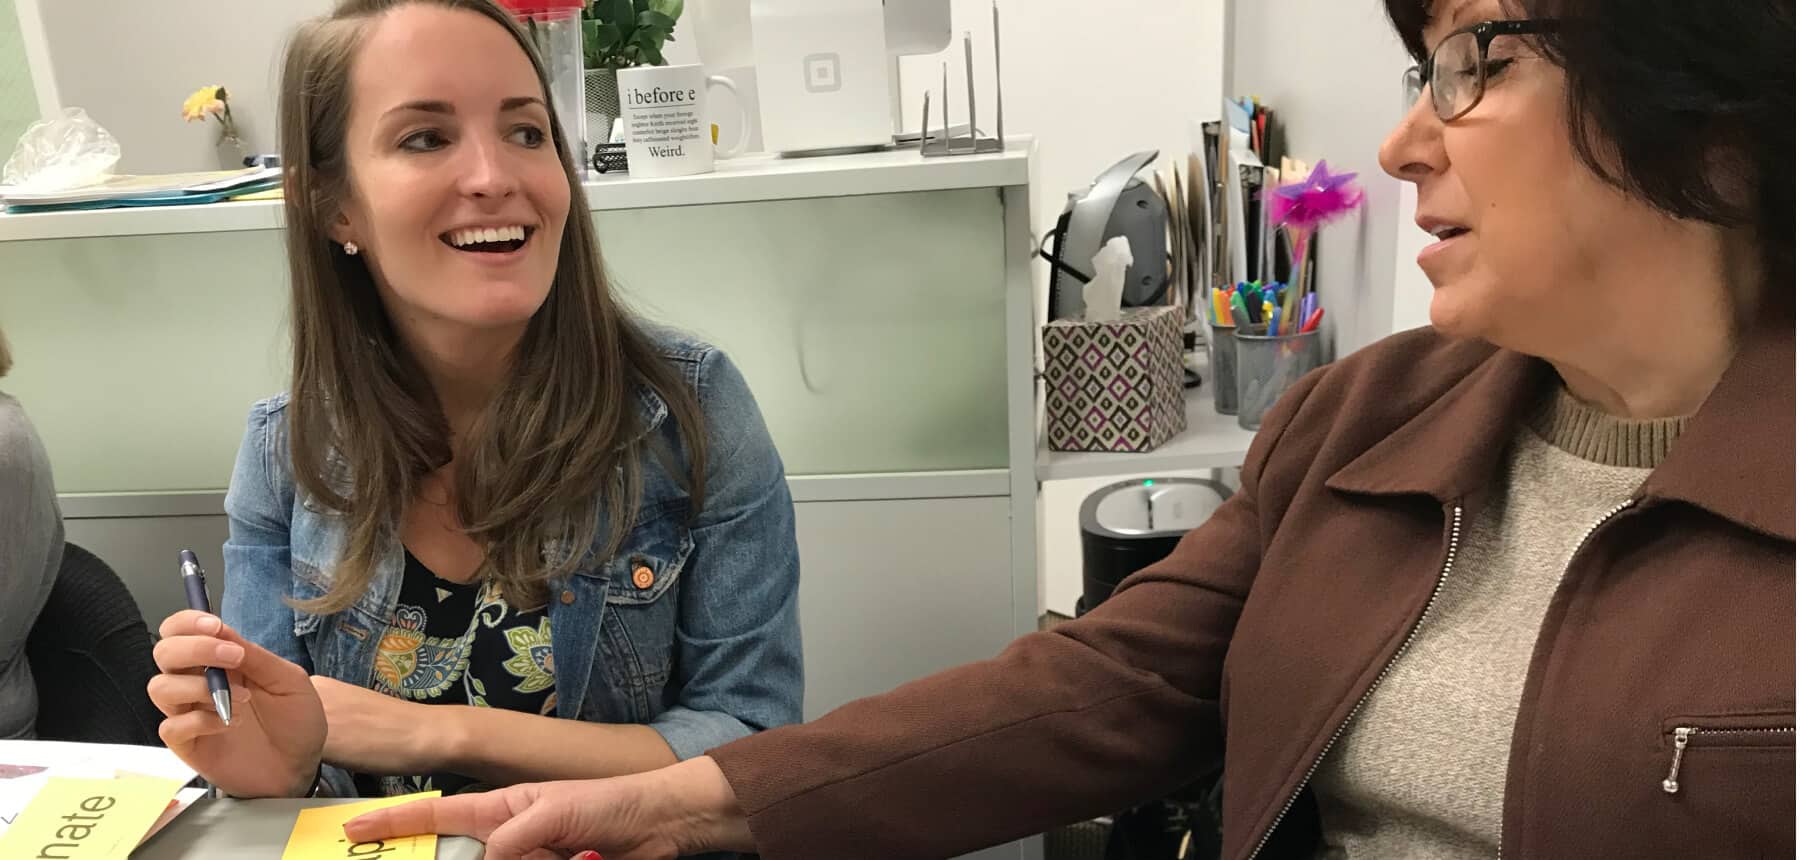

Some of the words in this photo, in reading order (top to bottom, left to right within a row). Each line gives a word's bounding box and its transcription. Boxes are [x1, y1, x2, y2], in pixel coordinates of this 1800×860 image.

[627, 88, 632, 104] i
[634, 86, 684, 105] before
[688, 89, 696, 101] e
[648, 144, 686, 158] Weird.
[36, 796, 116, 859] nate
